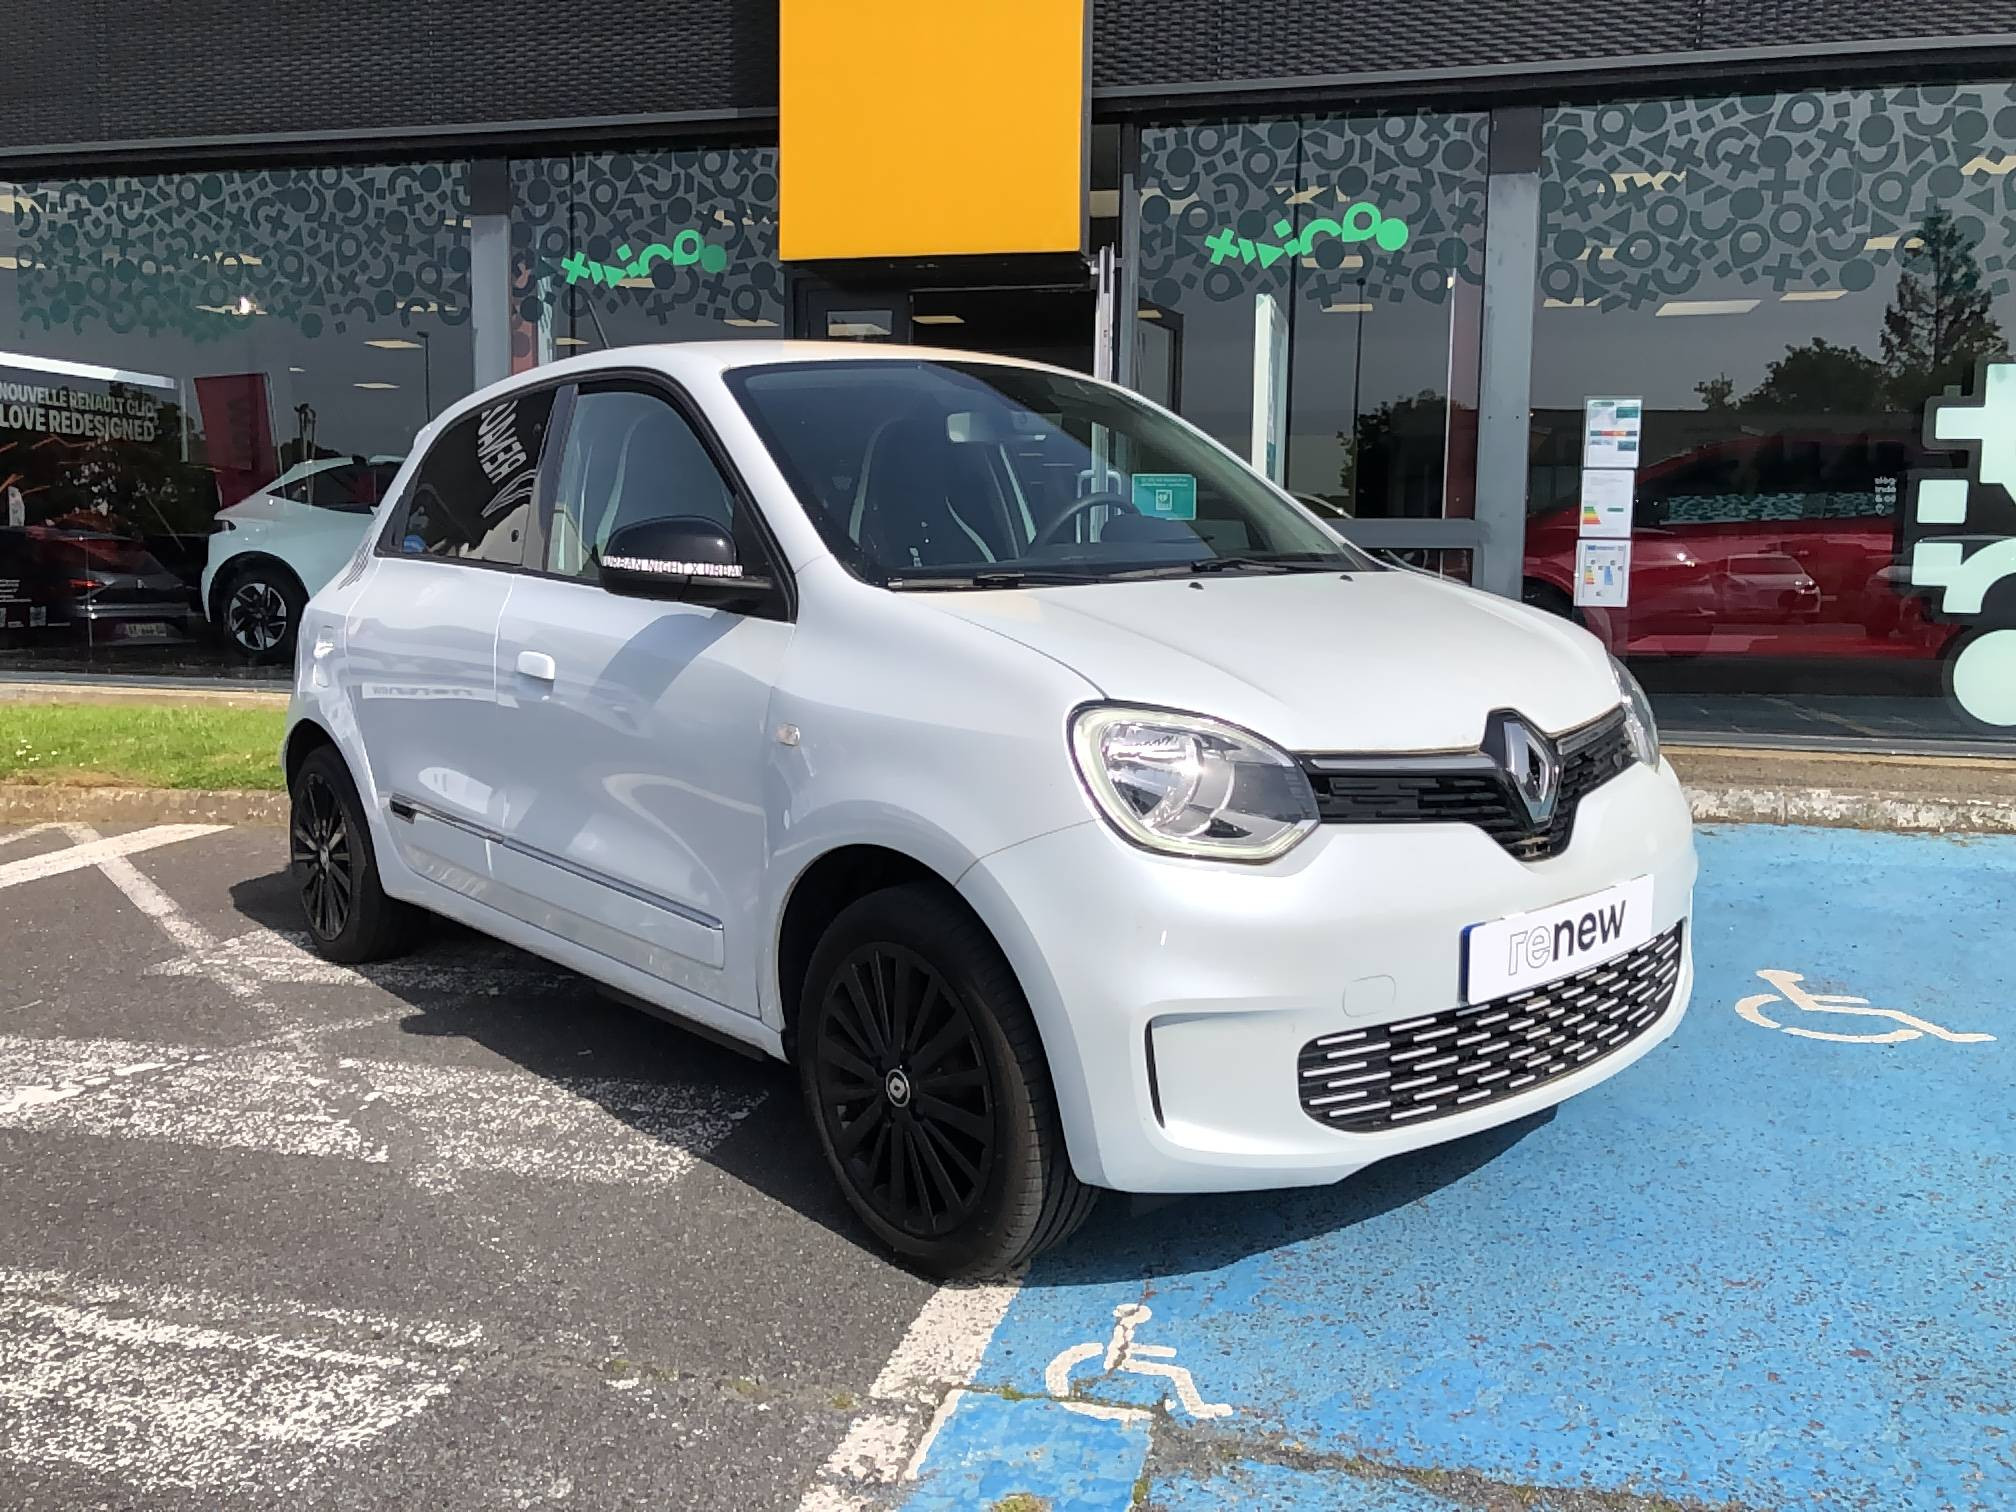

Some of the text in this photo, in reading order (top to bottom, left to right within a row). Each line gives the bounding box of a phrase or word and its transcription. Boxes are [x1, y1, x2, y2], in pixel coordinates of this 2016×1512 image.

[0, 382, 67, 408] NOUVELLE
[69, 392, 125, 414] RENAULT
[0, 403, 155, 442] LOVE REDESIGNED
[1508, 900, 1627, 976] renew
